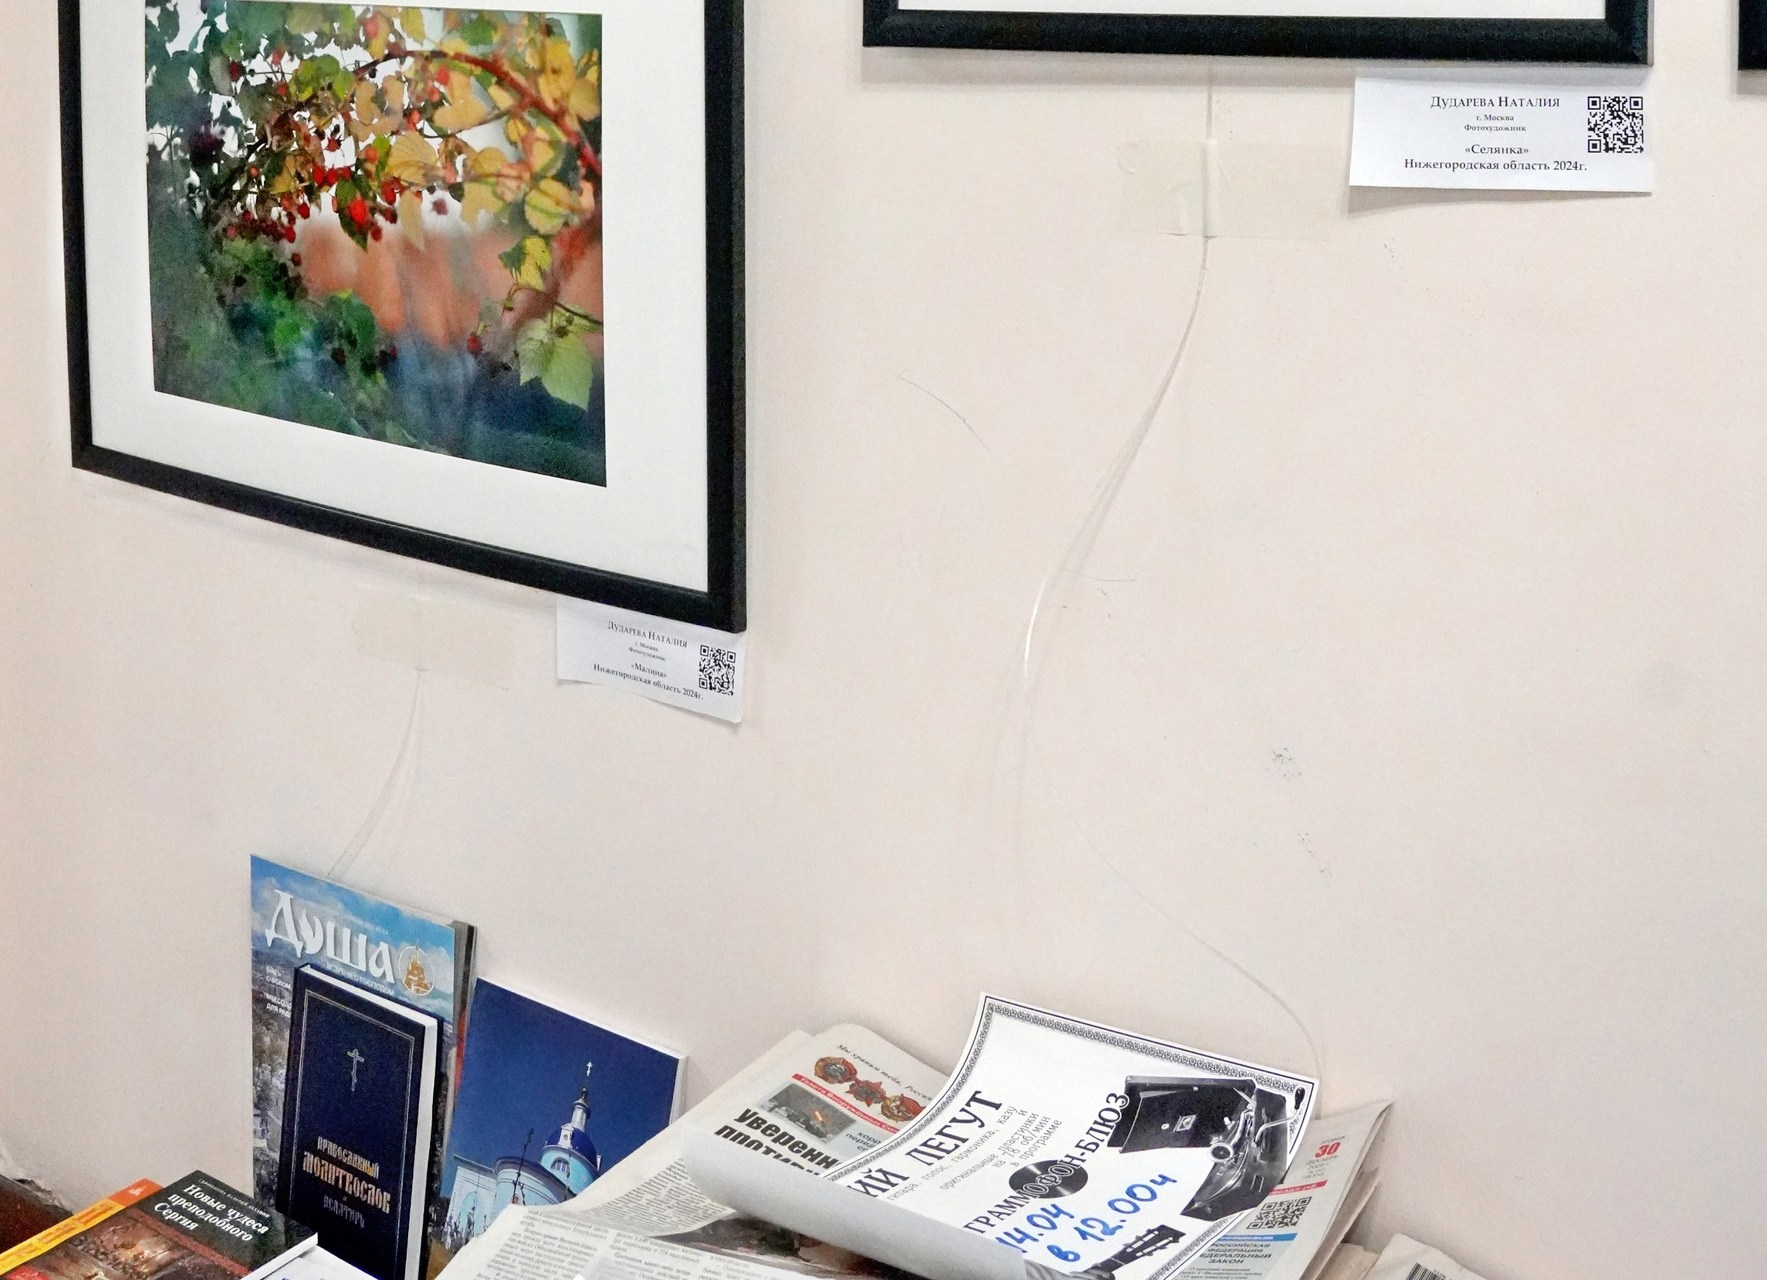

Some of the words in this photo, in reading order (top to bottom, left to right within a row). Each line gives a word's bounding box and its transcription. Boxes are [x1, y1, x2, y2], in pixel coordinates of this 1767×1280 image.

[1430, 96, 1495, 109] ДУДАРЕВА
[1498, 96, 1560, 108] НАТАЛИЯ
[1464, 124, 1527, 133] Фотохудожник
[1465, 143, 1529, 155] «Селянка»
[1404, 158, 1499, 172] Нижегородская
[1503, 160, 1550, 171] область
[1553, 161, 1588, 171] 2024г.
[593, 663, 652, 685] Нижегородская
[652, 678, 681, 694] область
[683, 687, 704, 700] 2024г.
[631, 663, 667, 678] «Малина»
[734, 1108, 842, 1169] уверенн
[905, 1091, 1003, 1166] ЛЕГУТ
[951, 1129, 999, 1162] гармоника,
[997, 1105, 1018, 1125] казу
[1002, 1149, 1020, 1158] 78
[1021, 1116, 1051, 1146] об/мин
[1019, 1119, 1062, 1161] программе
[1314, 1141, 1341, 1158] 30
[940, 1153, 999, 1190] оригинальные
[998, 1113, 1039, 1151] пластинки
[963, 1092, 1130, 1234] ГРАММОФОН-БЛЮЗ
[302, 1151, 391, 1214] МОЛИТВОСЛОВ
[154, 1202, 199, 1231] Сергия
[168, 1193, 253, 1242] преподобного
[183, 1184, 226, 1212] Новые
[227, 1207, 270, 1235] чудеса
[995, 1203, 1075, 1254] 14.04
